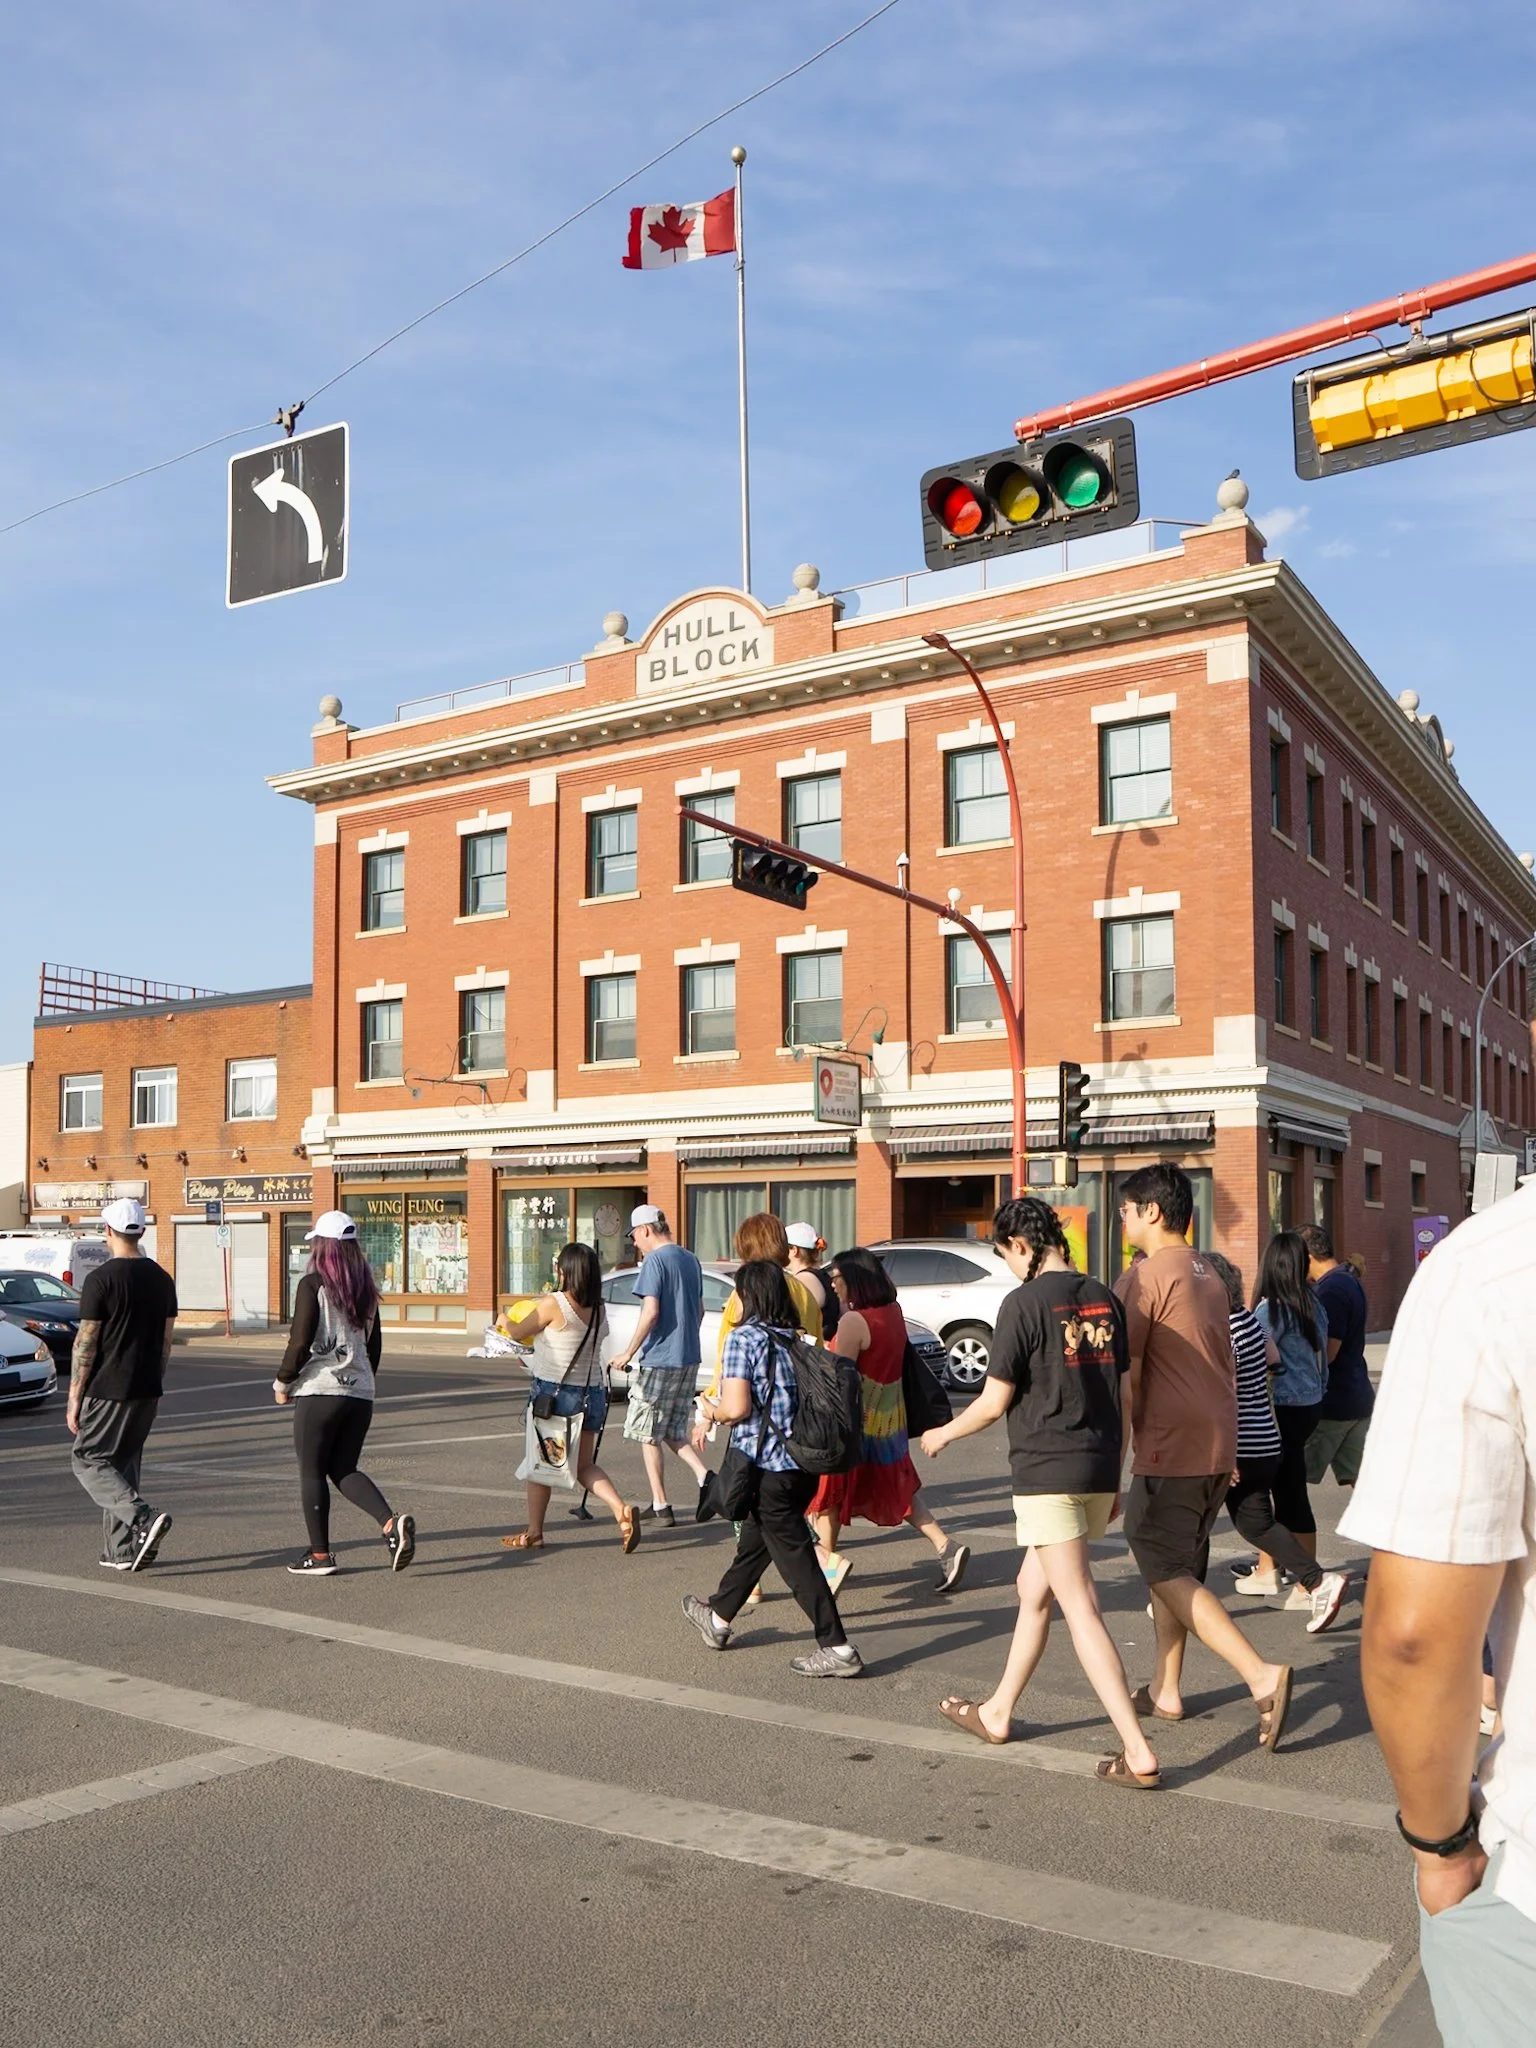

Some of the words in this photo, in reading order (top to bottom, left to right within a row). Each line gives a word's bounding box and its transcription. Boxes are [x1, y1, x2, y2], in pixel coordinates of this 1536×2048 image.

[664, 611, 746, 648] HULL
[649, 637, 760, 682] BLOCK
[223, 1179, 255, 1202] Ping
[257, 1192, 289, 1201] BEAUTY
[367, 1200, 402, 1214] WING
[408, 1198, 445, 1214] FUNG
